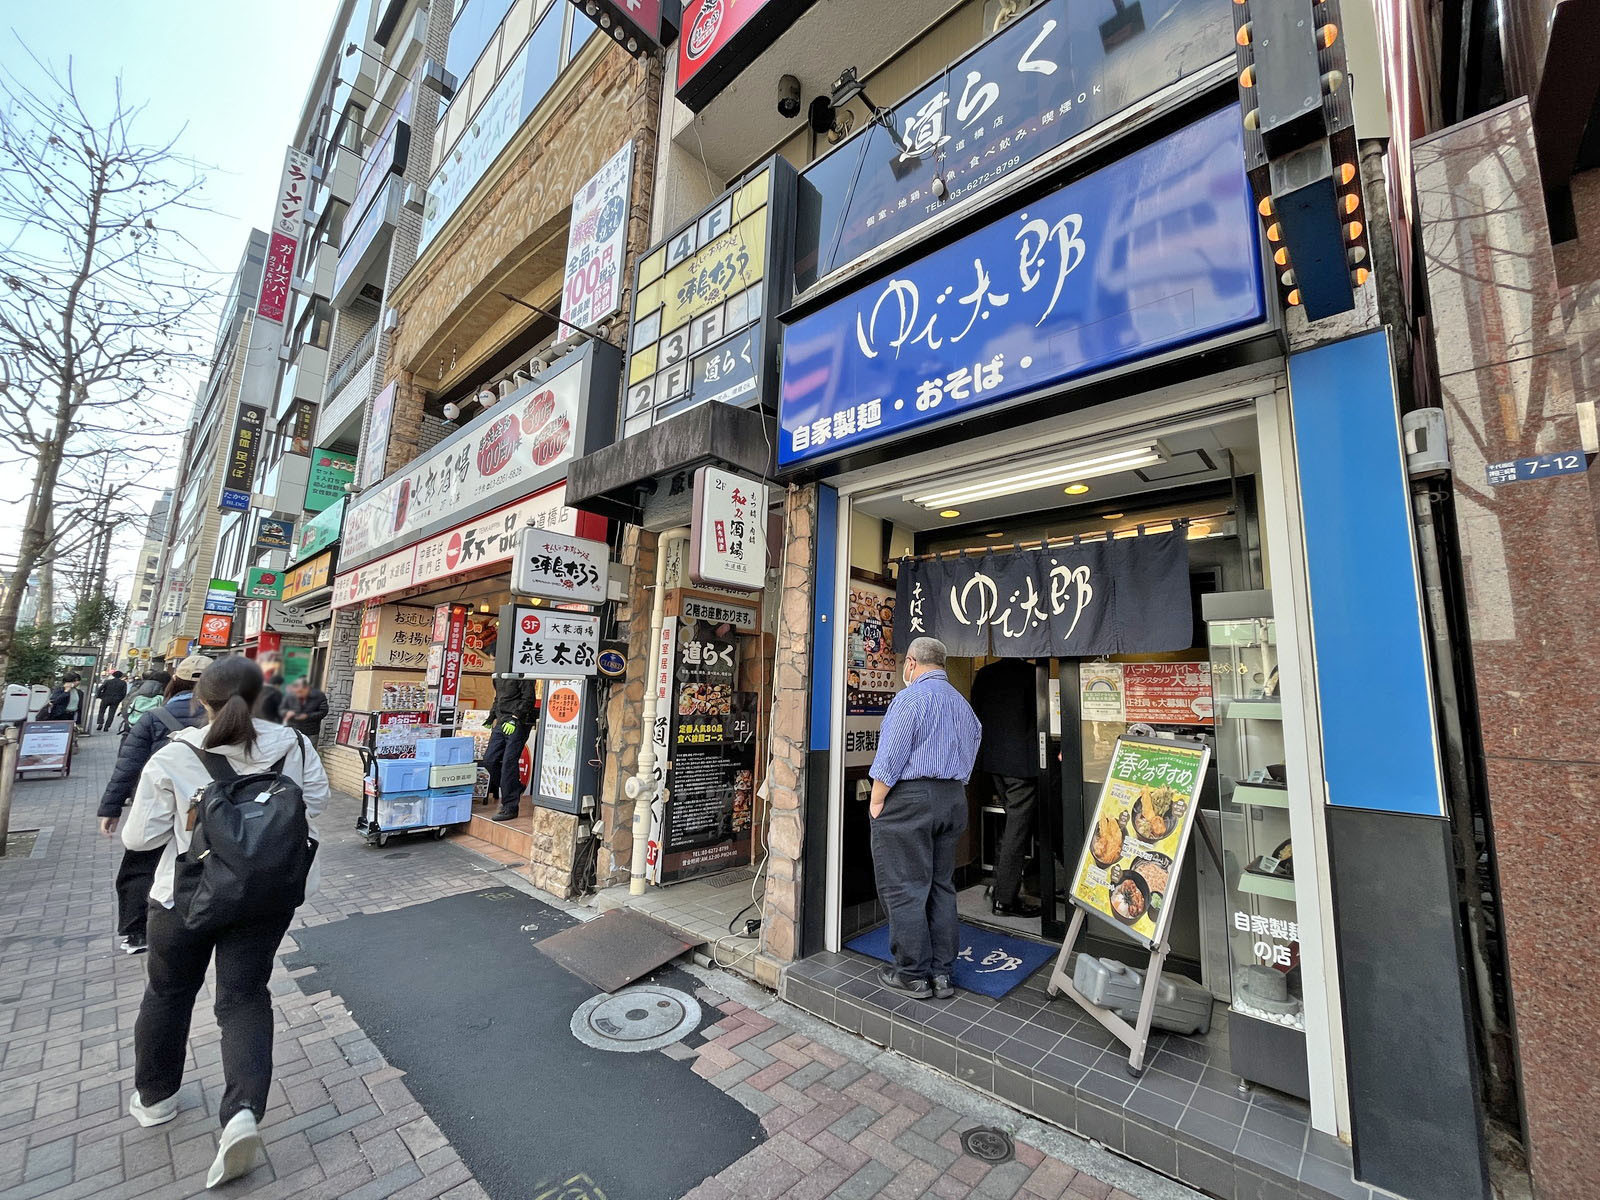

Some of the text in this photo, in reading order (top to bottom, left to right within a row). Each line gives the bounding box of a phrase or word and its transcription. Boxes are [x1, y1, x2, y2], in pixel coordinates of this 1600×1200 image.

[899, 19, 1058, 163] 道らく
[865, 83, 1102, 228] 個室、地鶏、魚、食べ飲み、喫煙OK
[935, 114, 1004, 162] 水道橋店
[281, 164, 307, 219] ラーメン
[950, 155, 1021, 201] 03-6272-8799
[672, 208, 722, 260] 4F
[271, 244, 294, 305] ガールズバー
[676, 245, 749, 310] 浦島たろう
[856, 212, 1086, 361] ゆで太郎
[667, 314, 716, 366] 3F
[703, 338, 752, 384] 道らく
[634, 367, 681, 413] 2F
[232, 450, 249, 478] 足つぼ
[1524, 455, 1580, 475] 7-12
[223, 491, 250, 501] たかの
[715, 478, 727, 491] 2F
[730, 487, 747, 561] 和み酒場
[530, 554, 600, 588] 浦島たろう
[685, 602, 753, 625] 2階お座敷あります。
[950, 558, 1093, 641] ゆで太郎
[522, 620, 539, 631] 3F
[551, 622, 595, 638] 大衆酒場
[518, 637, 597, 668] 龍太郎
[682, 640, 734, 668] 道らく
[1170, 672, 1212, 687] 大募集
[677, 732, 724, 744] 食べ放題コース
[678, 723, 723, 734] 定番人気80品
[734, 720, 747, 731] 2F
[1117, 751, 1193, 787] 春のおすすめ
[1253, 941, 1292, 967] の店
